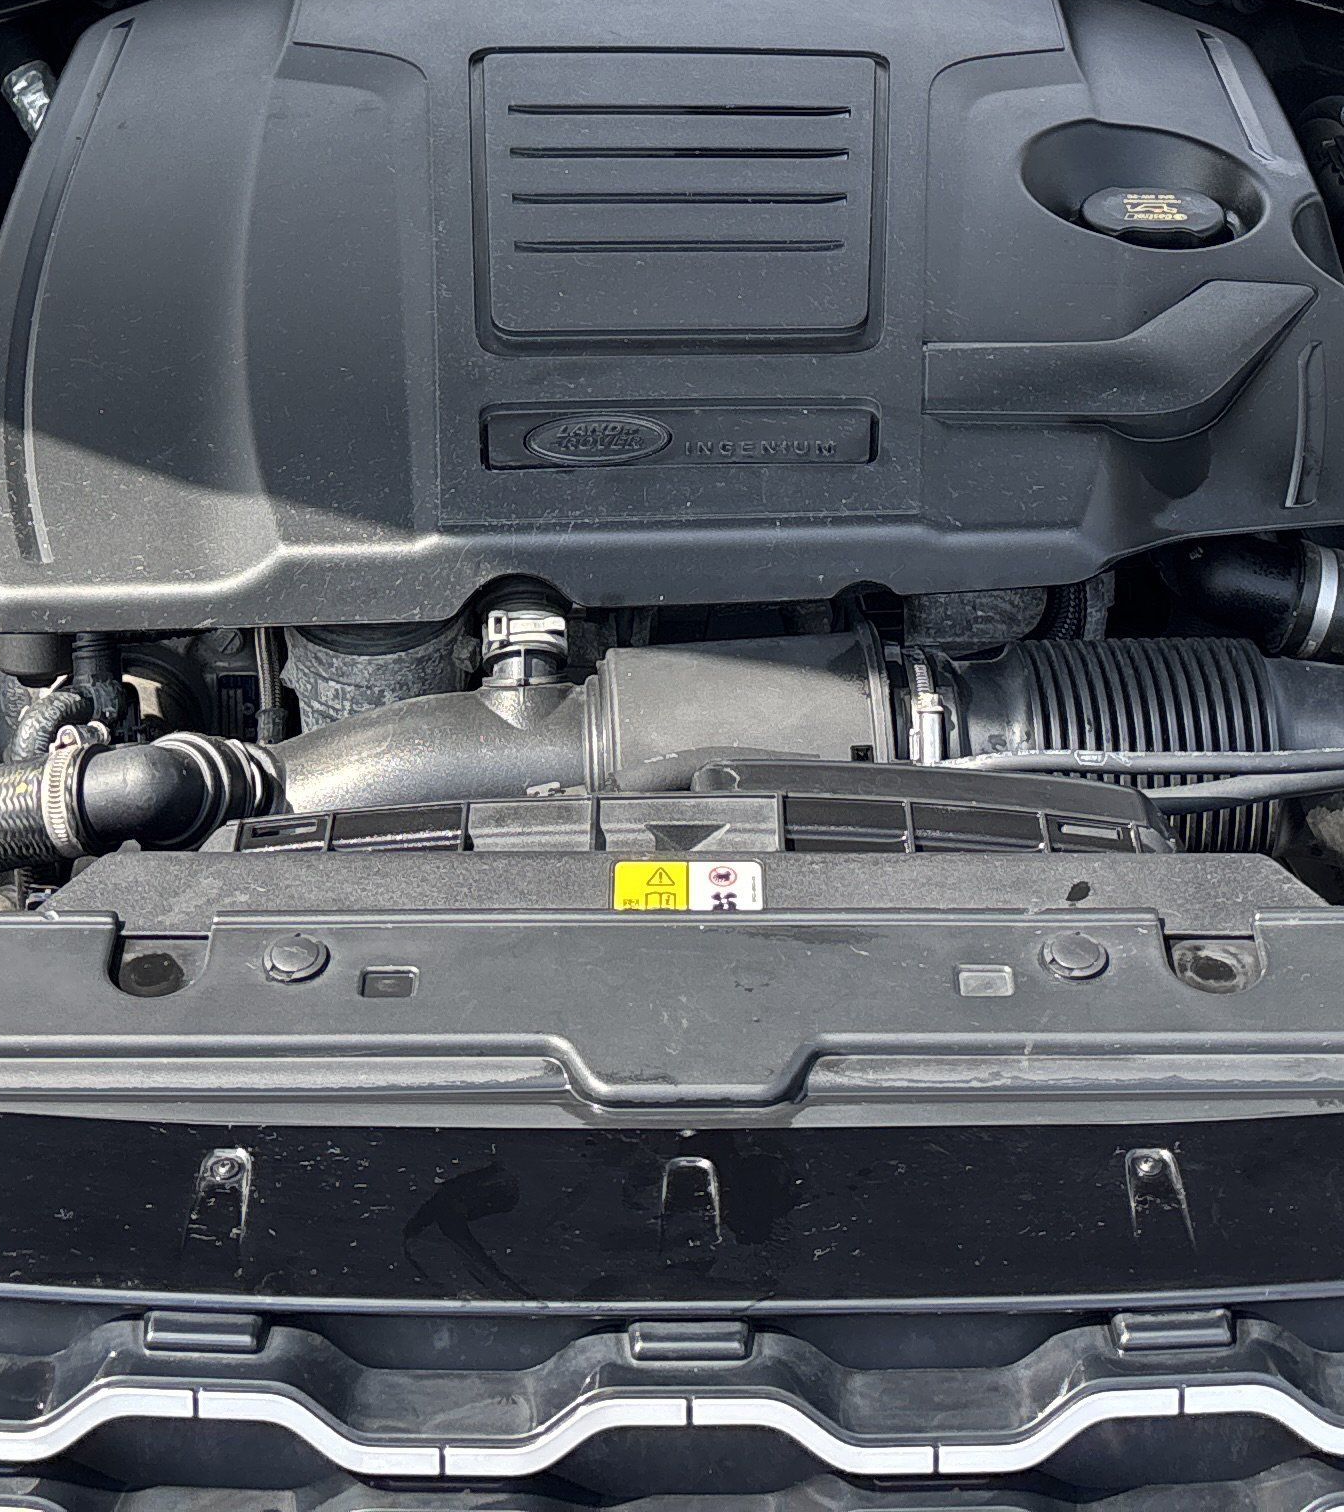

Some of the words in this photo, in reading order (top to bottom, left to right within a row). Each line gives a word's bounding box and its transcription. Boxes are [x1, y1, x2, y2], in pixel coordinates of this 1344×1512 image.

[557, 423, 623, 437] LAND
[560, 436, 643, 451] ROVER
[685, 440, 837, 456] INGENIUM
